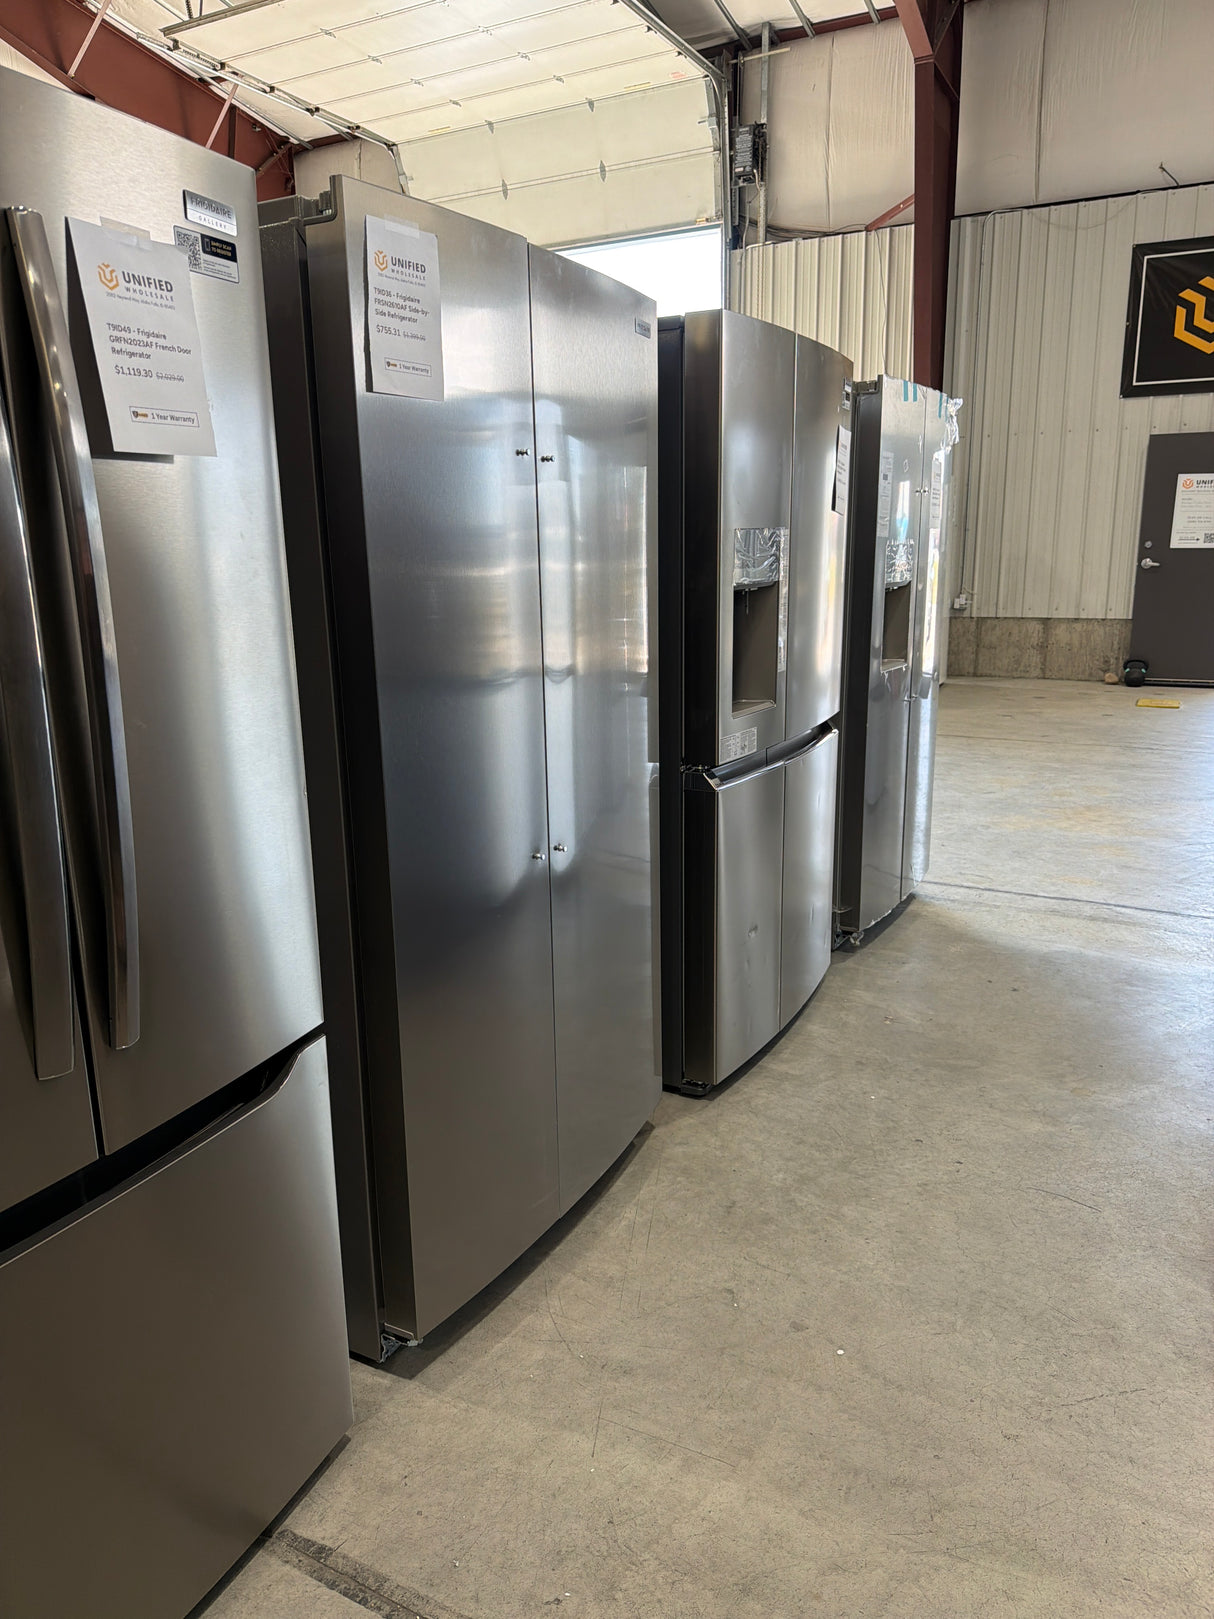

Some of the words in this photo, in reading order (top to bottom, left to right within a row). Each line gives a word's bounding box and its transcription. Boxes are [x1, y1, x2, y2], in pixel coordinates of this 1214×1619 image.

[191, 197, 232, 219] FRIGIDAIRE
[199, 216, 226, 229] GALLERY
[391, 256, 426, 273] UNIFIED
[122, 270, 173, 293] UNIFIED
[391, 268, 425, 281] WHOLESALE
[125, 286, 174, 302] WHOLESALE
[396, 292, 420, 304] Frigidaire
[375, 308, 387, 317] Side
[387, 311, 418, 323] Refrigerator
[137, 328, 167, 340] Frigidaire
[376, 324, 401, 337] $755.31
[109, 335, 154, 349] GRFN2023AF
[155, 342, 177, 353] French
[177, 346, 192, 355] Door
[111, 346, 151, 360] Refrigerator
[114, 364, 153, 379] $1,119.30
[155, 413, 169, 421] Year
[169, 414, 195, 425] Warranty
